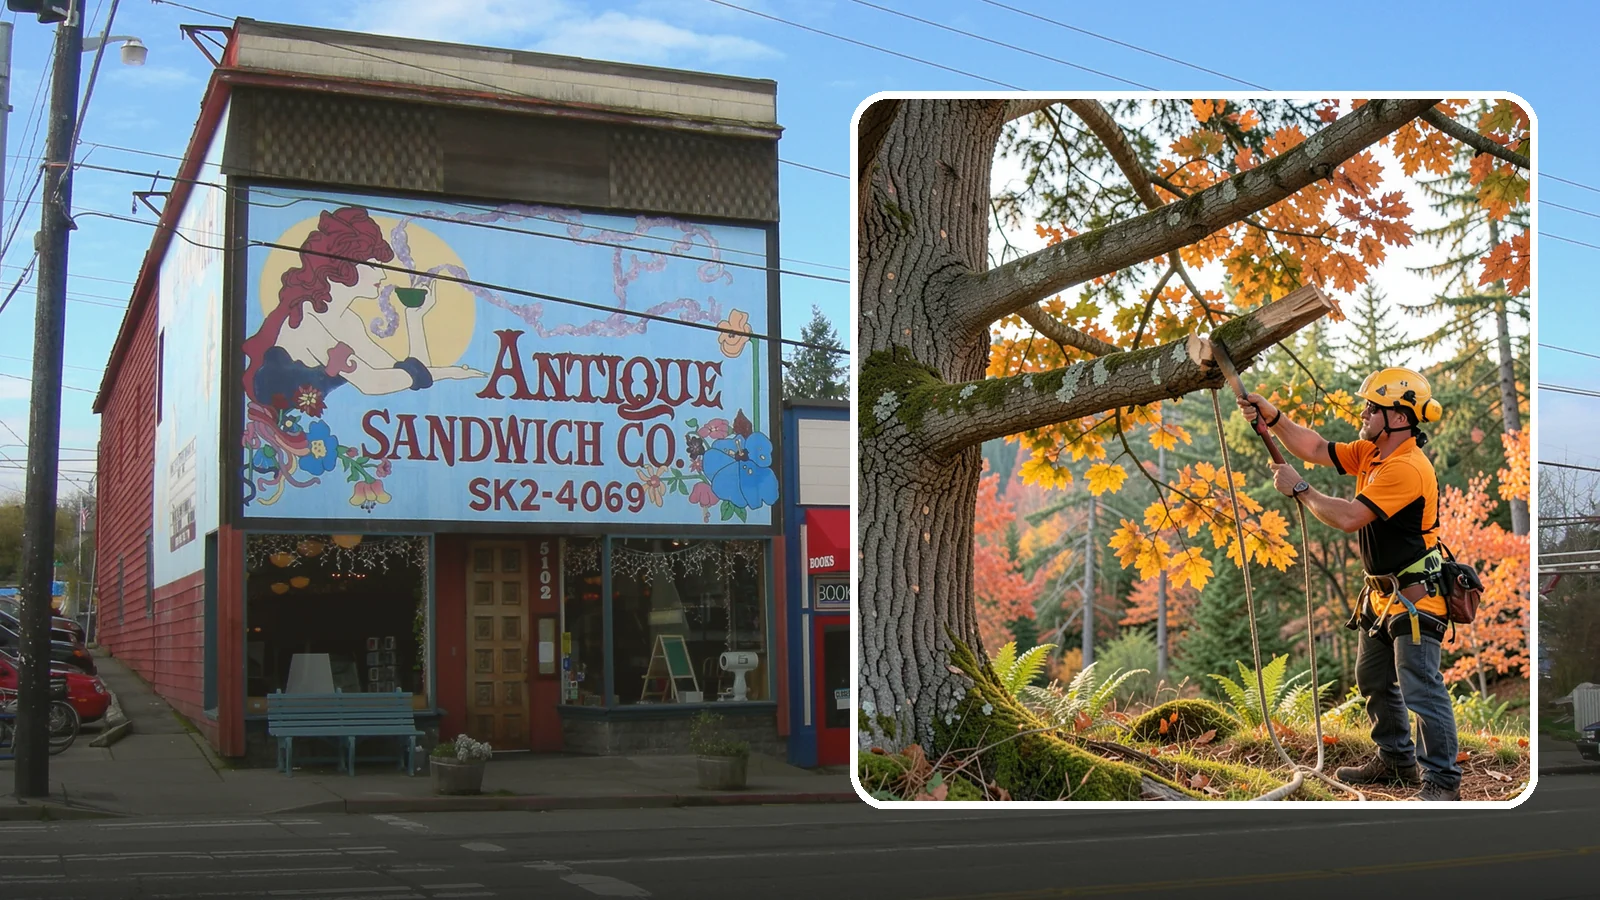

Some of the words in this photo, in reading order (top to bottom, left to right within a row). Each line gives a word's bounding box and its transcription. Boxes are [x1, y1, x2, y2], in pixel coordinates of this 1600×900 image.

[475, 328, 724, 420] ANTIQUE
[361, 408, 605, 468] SANDWICH
[618, 421, 685, 470] CO.
[468, 477, 646, 513] SK2-4069
[539, 542, 552, 599] 5102
[809, 555, 835, 569] BOOKS
